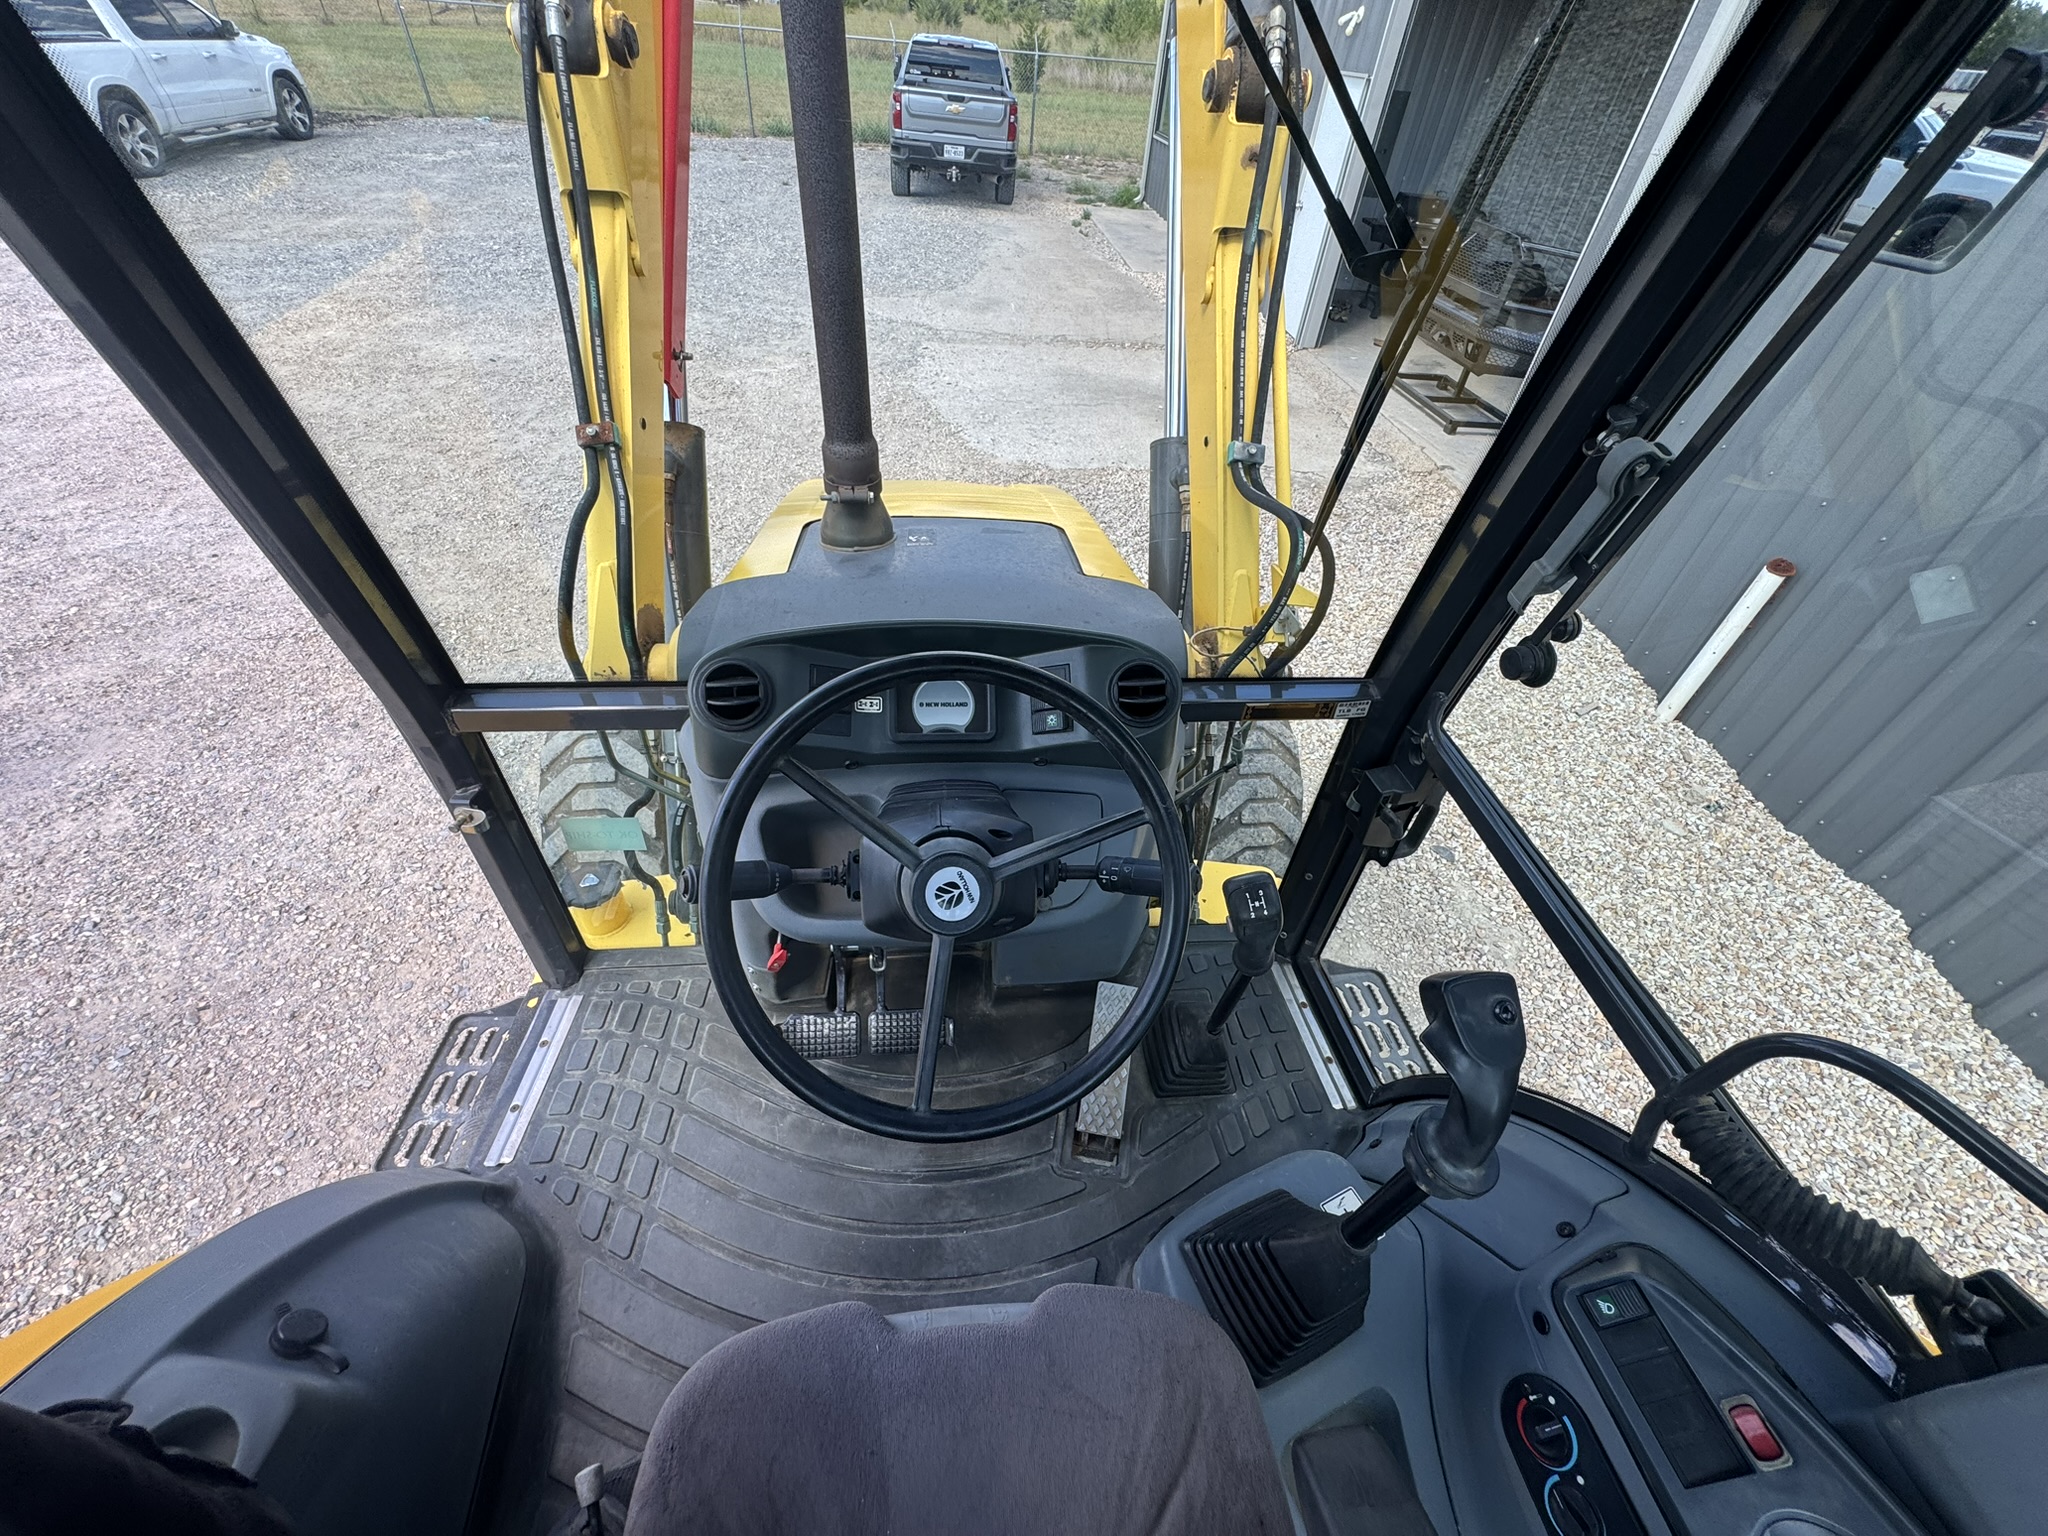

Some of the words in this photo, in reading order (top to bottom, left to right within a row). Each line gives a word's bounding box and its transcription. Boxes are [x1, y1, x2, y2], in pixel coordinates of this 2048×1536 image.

[567, 121, 575, 140] FLAME
[956, 870, 971, 894] HOLLAND
[965, 893, 976, 904] NEW
